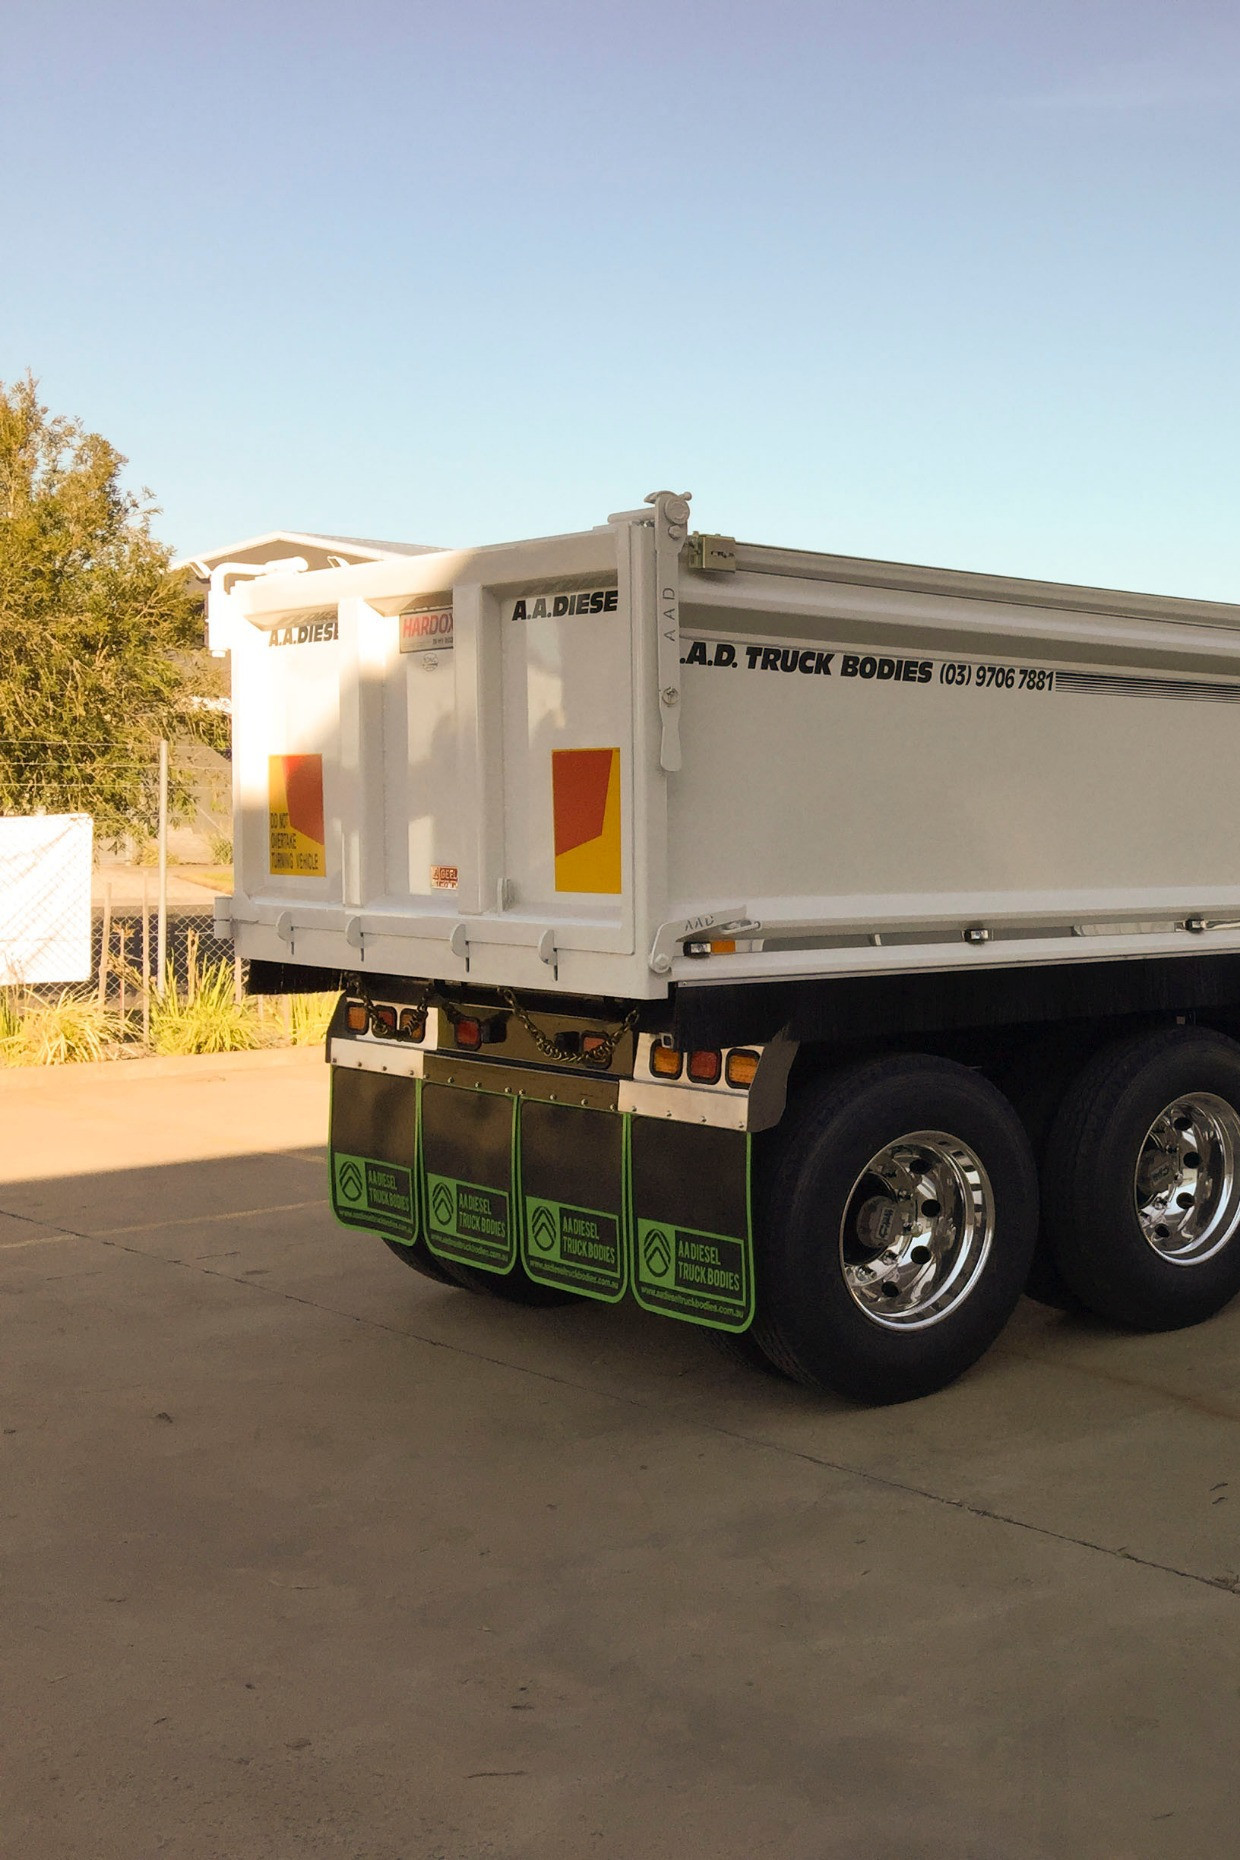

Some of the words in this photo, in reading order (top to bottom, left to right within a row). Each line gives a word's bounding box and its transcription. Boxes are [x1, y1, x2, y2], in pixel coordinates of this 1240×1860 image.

[746, 646, 835, 675] TRUCK
[840, 655, 933, 684] BODIES
[939, 663, 972, 686] (03)
[975, 665, 1016, 689] 9706
[1018, 669, 1054, 691] 7881
[459, 1211, 481, 1231] TRUCK
[481, 1217, 506, 1238] BODIES
[562, 1236, 588, 1257] TRUCK
[588, 1242, 615, 1264] BODIES
[677, 1261, 707, 1283] TRUCK
[707, 1268, 740, 1292] BODIES
